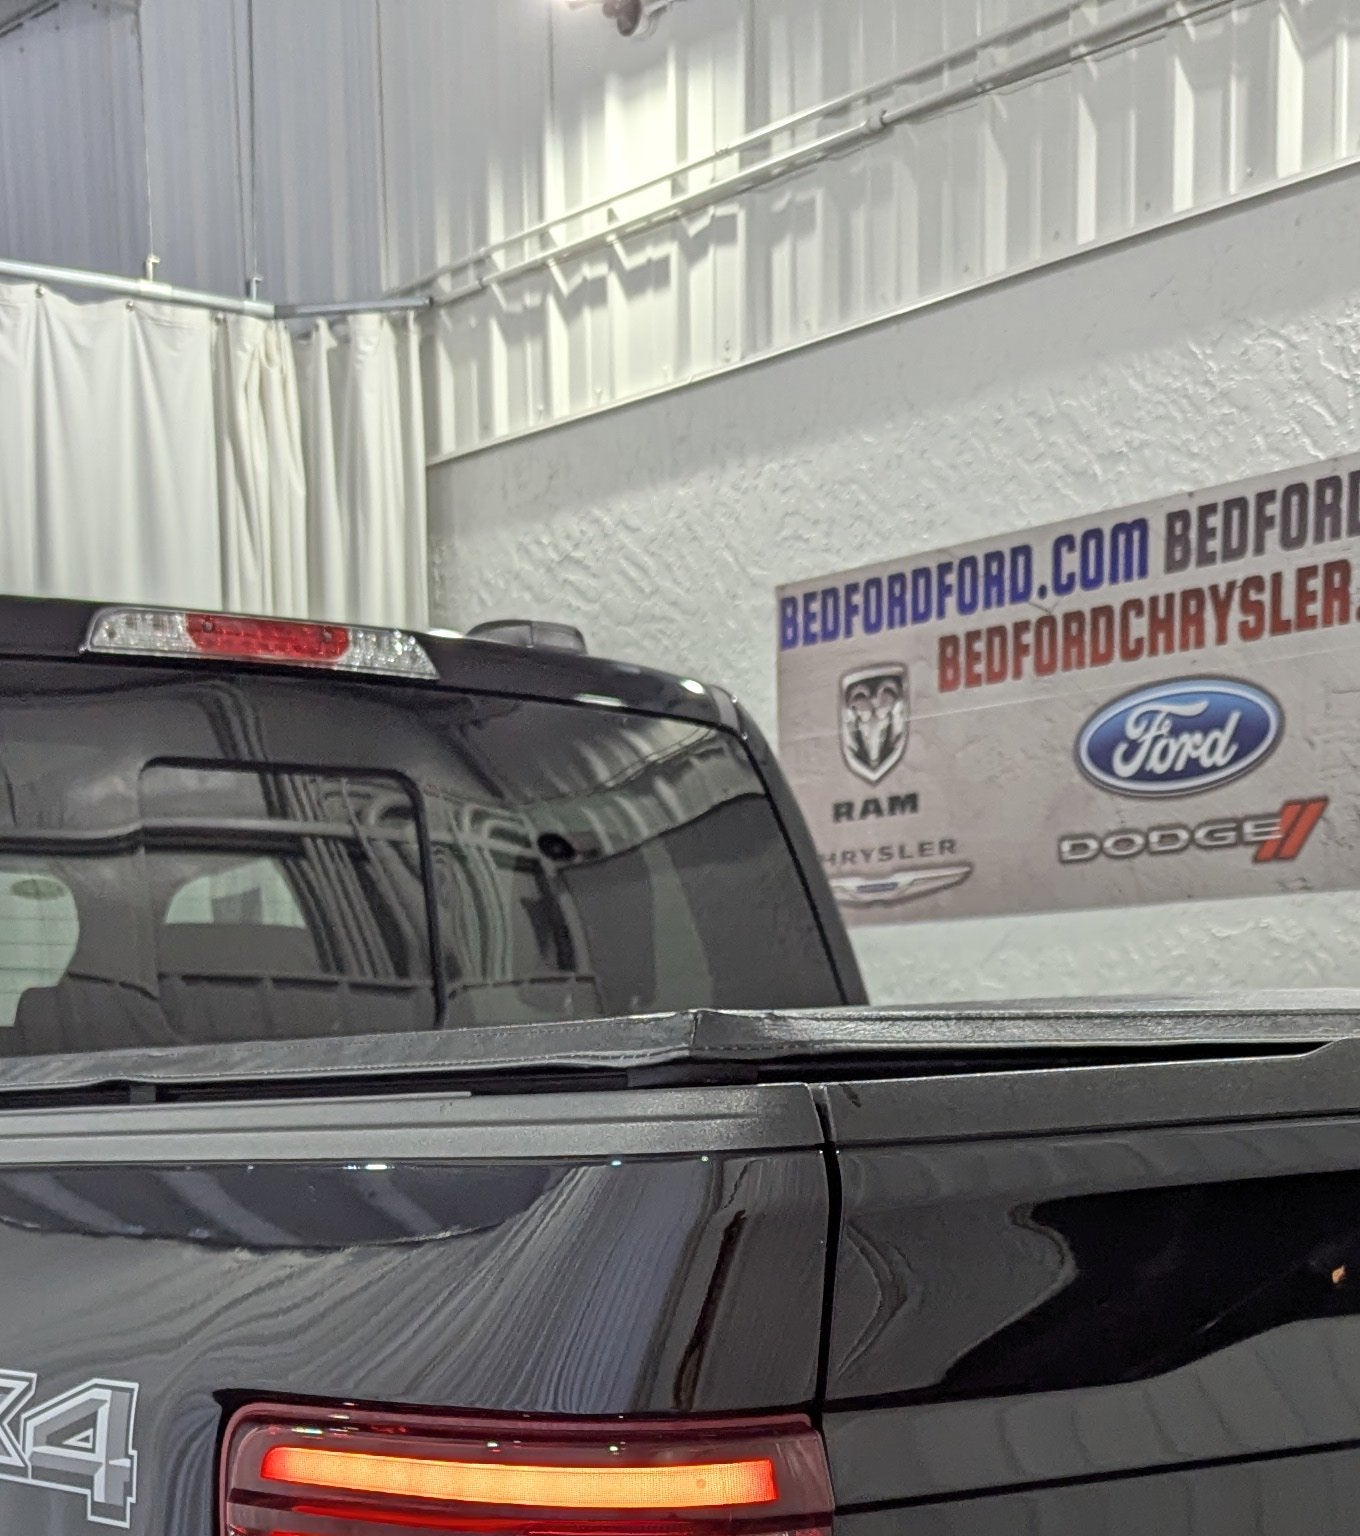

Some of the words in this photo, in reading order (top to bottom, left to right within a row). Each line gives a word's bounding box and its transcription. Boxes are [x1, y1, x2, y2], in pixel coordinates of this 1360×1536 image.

[780, 517, 1149, 652] BEDFORDFORD.COM
[1112, 700, 1241, 778] Ford
[832, 792, 919, 824] RAM
[817, 838, 957, 868] HRYSLER
[1058, 812, 1285, 864] DODGE
